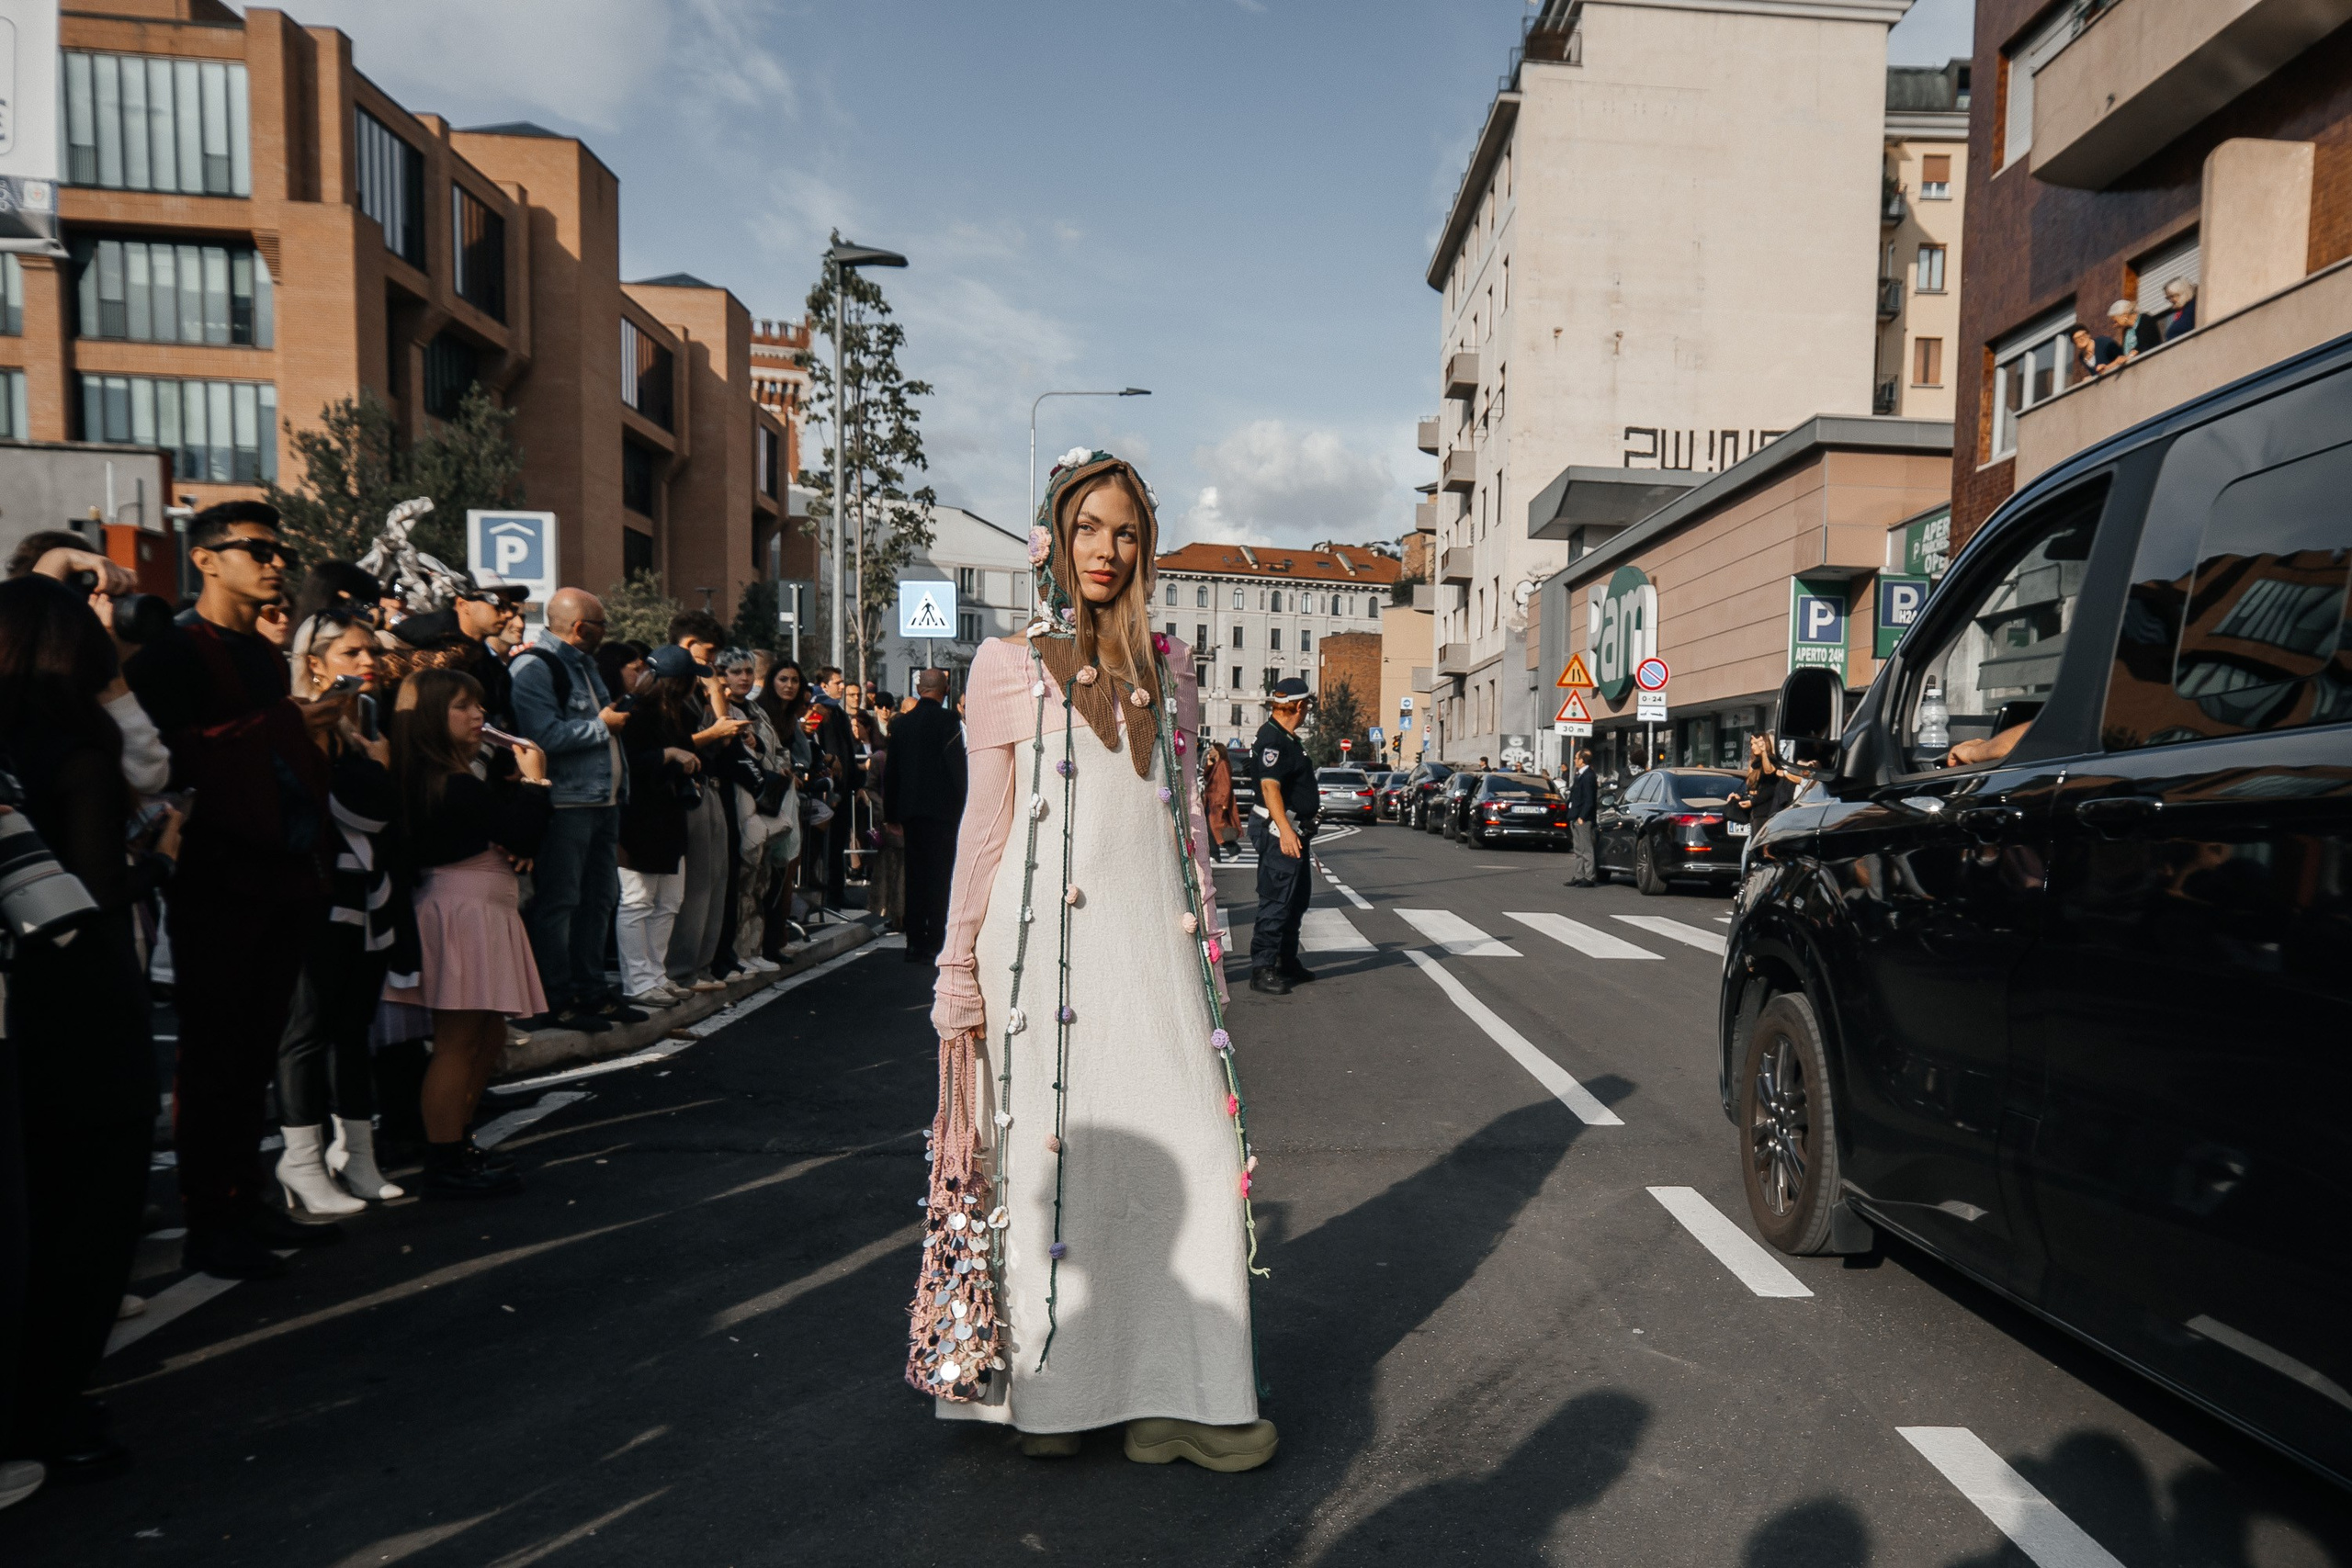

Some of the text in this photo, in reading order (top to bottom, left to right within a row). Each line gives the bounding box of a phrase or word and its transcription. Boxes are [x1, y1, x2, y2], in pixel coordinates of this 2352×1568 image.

[496, 535, 528, 575] P
[1808, 600, 1836, 639] P
[1892, 585, 1918, 624] P
[1587, 584, 1657, 689] Pam
[1794, 647, 1845, 663] APERTO 24H
